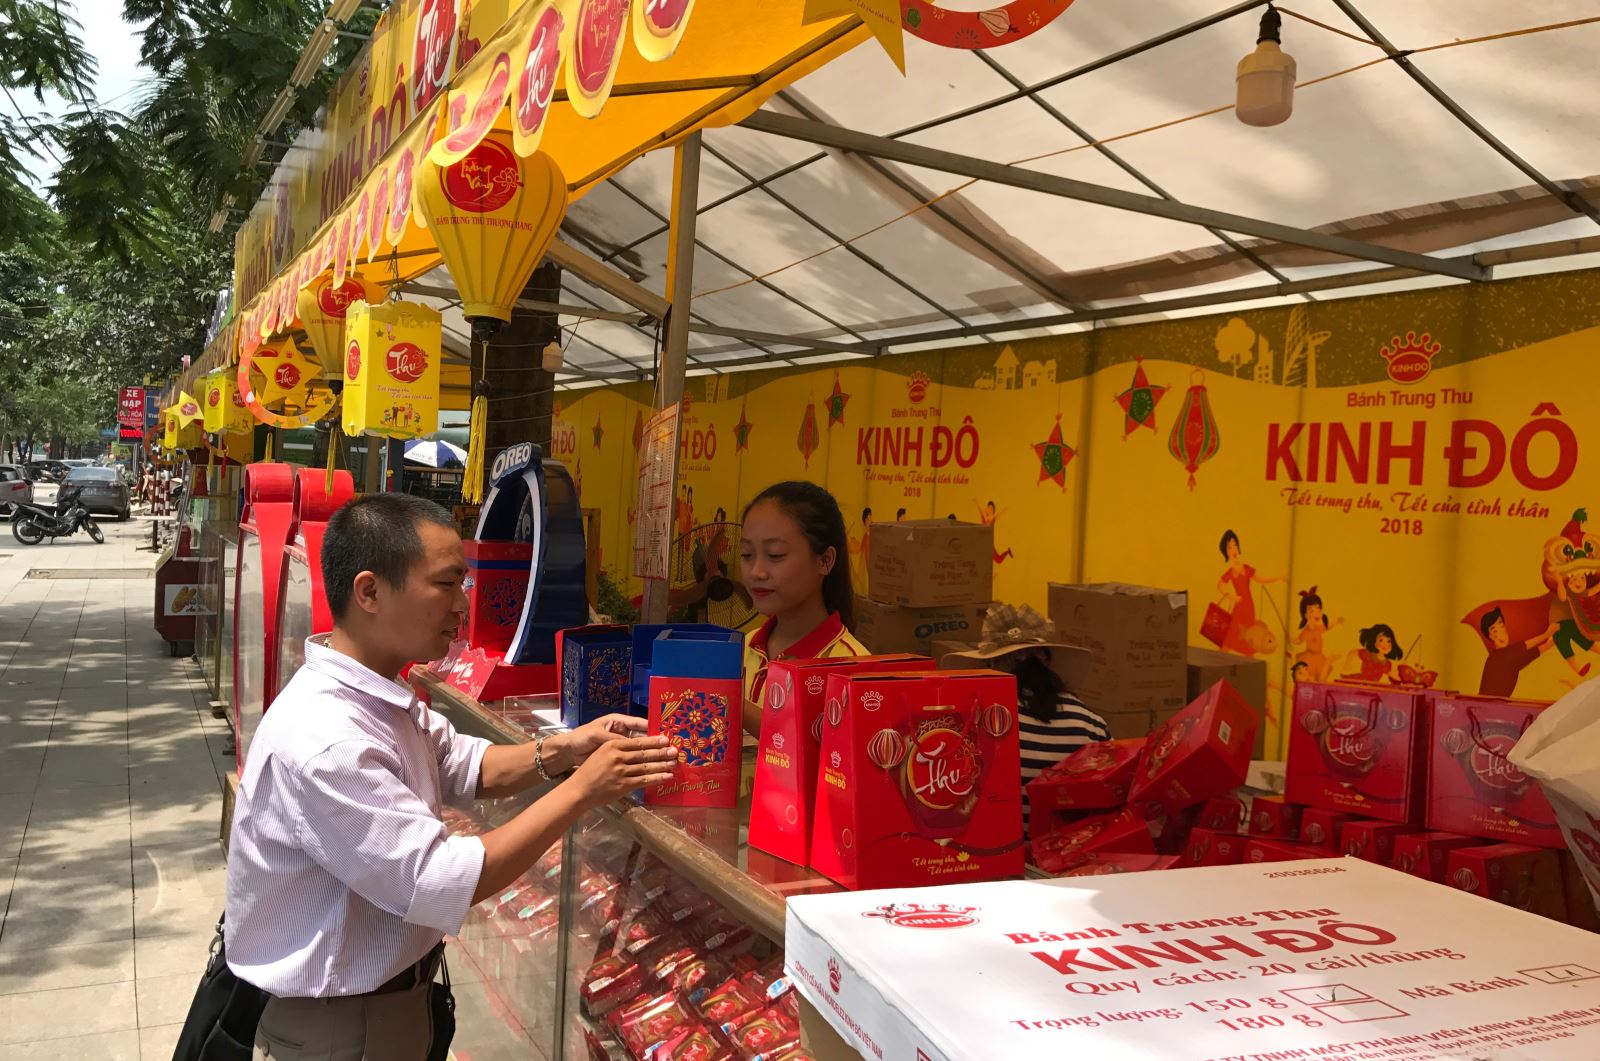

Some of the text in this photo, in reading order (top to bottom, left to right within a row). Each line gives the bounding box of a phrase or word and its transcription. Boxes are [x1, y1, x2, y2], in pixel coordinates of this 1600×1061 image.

[126, 389, 139, 398] XE
[1347, 388, 1473, 409] Bánh Trung Thu
[692, 423, 717, 460] ĐÔ
[857, 415, 979, 469] KINH ĐÔ
[1265, 401, 1579, 491] KINH ĐÔ
[491, 445, 530, 480] OREO
[1280, 487, 1312, 506] Tết
[1314, 495, 1353, 513] trung
[1389, 491, 1428, 513] Tết
[1431, 496, 1461, 514] của
[1506, 498, 1551, 519] thân
[1380, 517, 1424, 536] 2018
[914, 620, 969, 639] OREO
[765, 754, 780, 766] KINH
[915, 741, 973, 796] Thu
[825, 773, 838, 786] KINH
[900, 918, 944, 926] KINH
[1002, 906, 1341, 945] Bánh Trung Thu
[1029, 918, 1397, 976] KINH ĐÔ
[1064, 944, 1467, 996] Quy cách: 20 cái/thùng
[1399, 976, 1530, 1000] Mã Bánh
[1009, 995, 1290, 1031] Trọng lượng: 150 g
[1215, 1013, 1324, 1031] 180 g
[871, 1038, 884, 1061] NAM
[1248, 1048, 1311, 1061] TNHH
[1425, 1028, 1472, 1042] VIÊN
[1468, 1021, 1519, 1034] KINH
